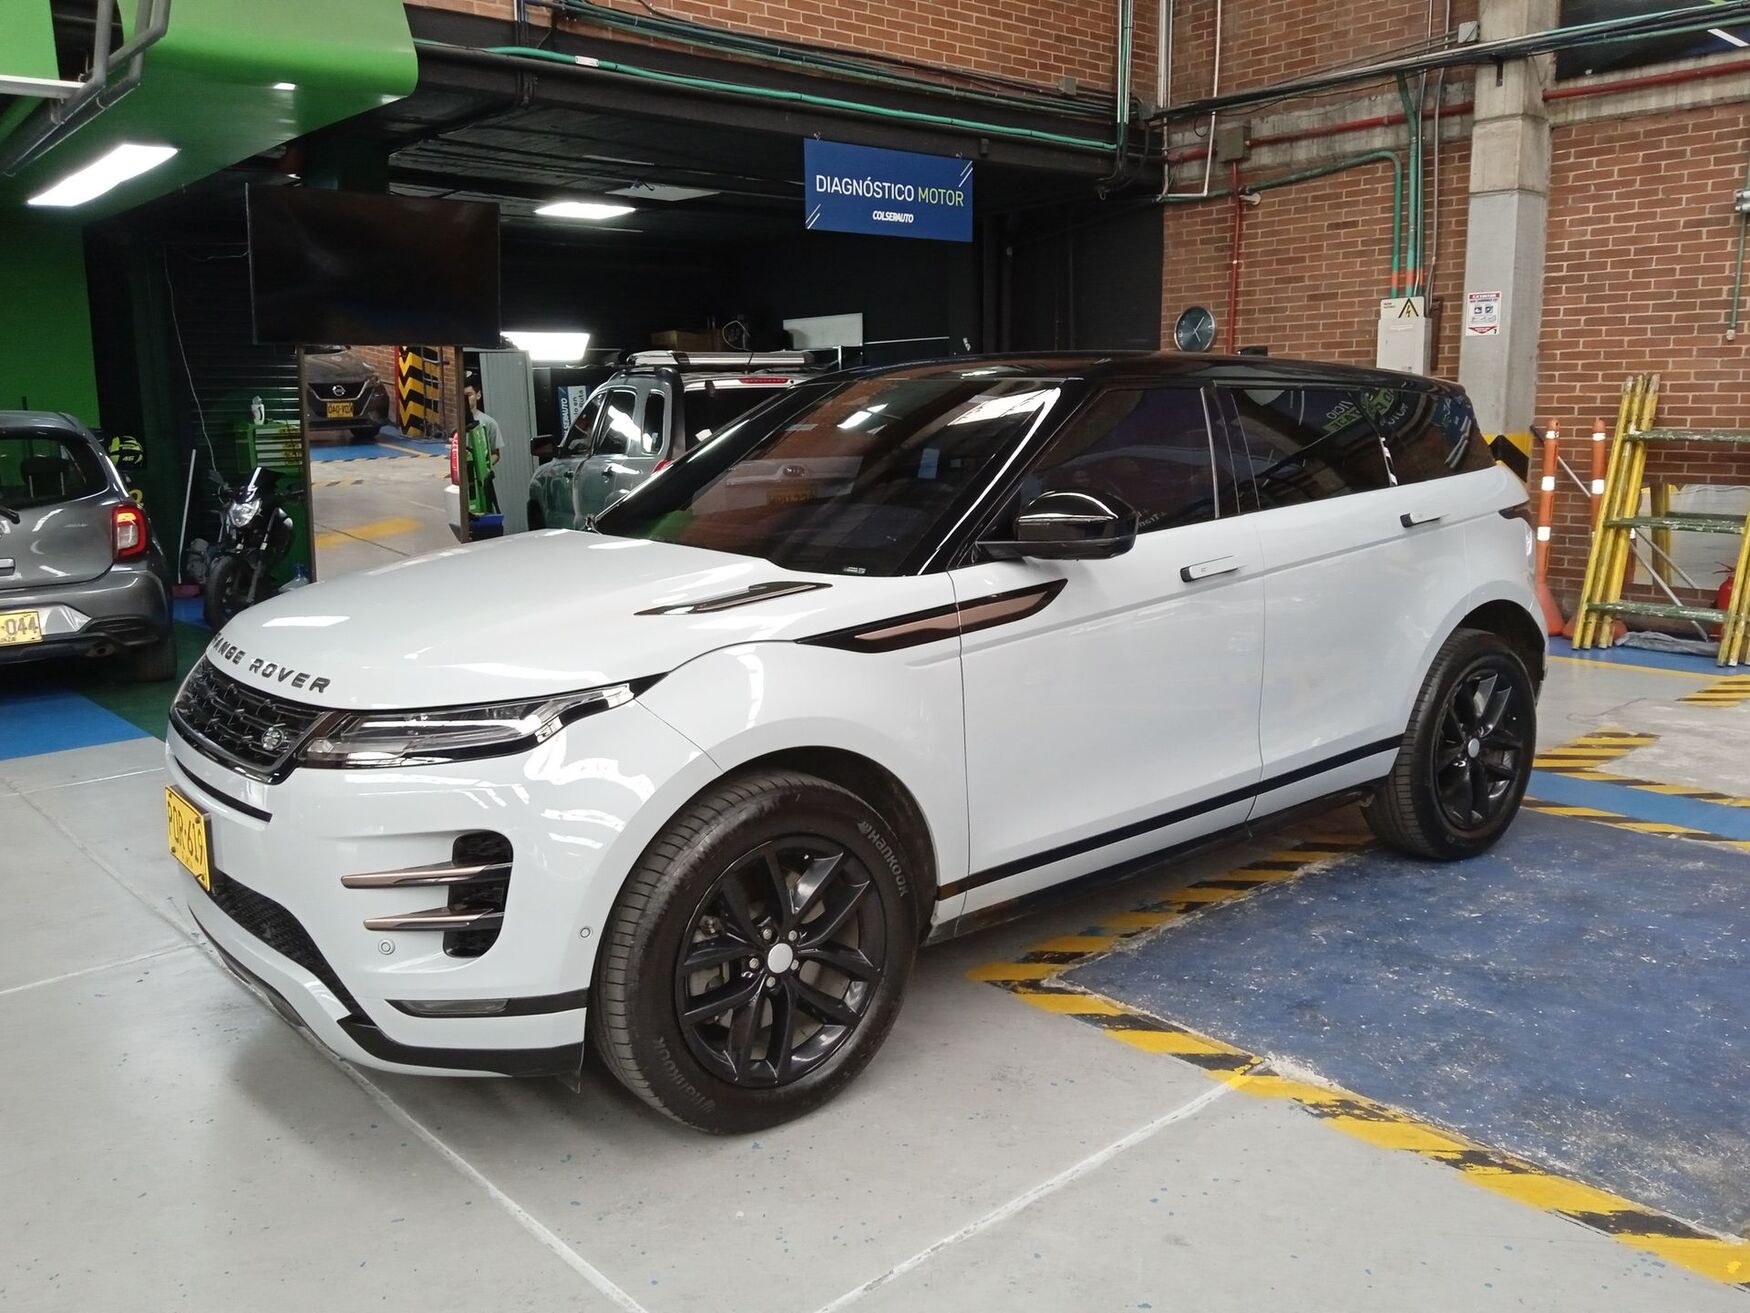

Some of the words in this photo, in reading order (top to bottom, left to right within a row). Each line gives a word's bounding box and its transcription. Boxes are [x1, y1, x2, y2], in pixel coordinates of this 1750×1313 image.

[816, 174, 914, 202] DIAGNÓSTICO
[918, 186, 964, 206] MOTOR
[248, 658, 331, 694] ROVER
